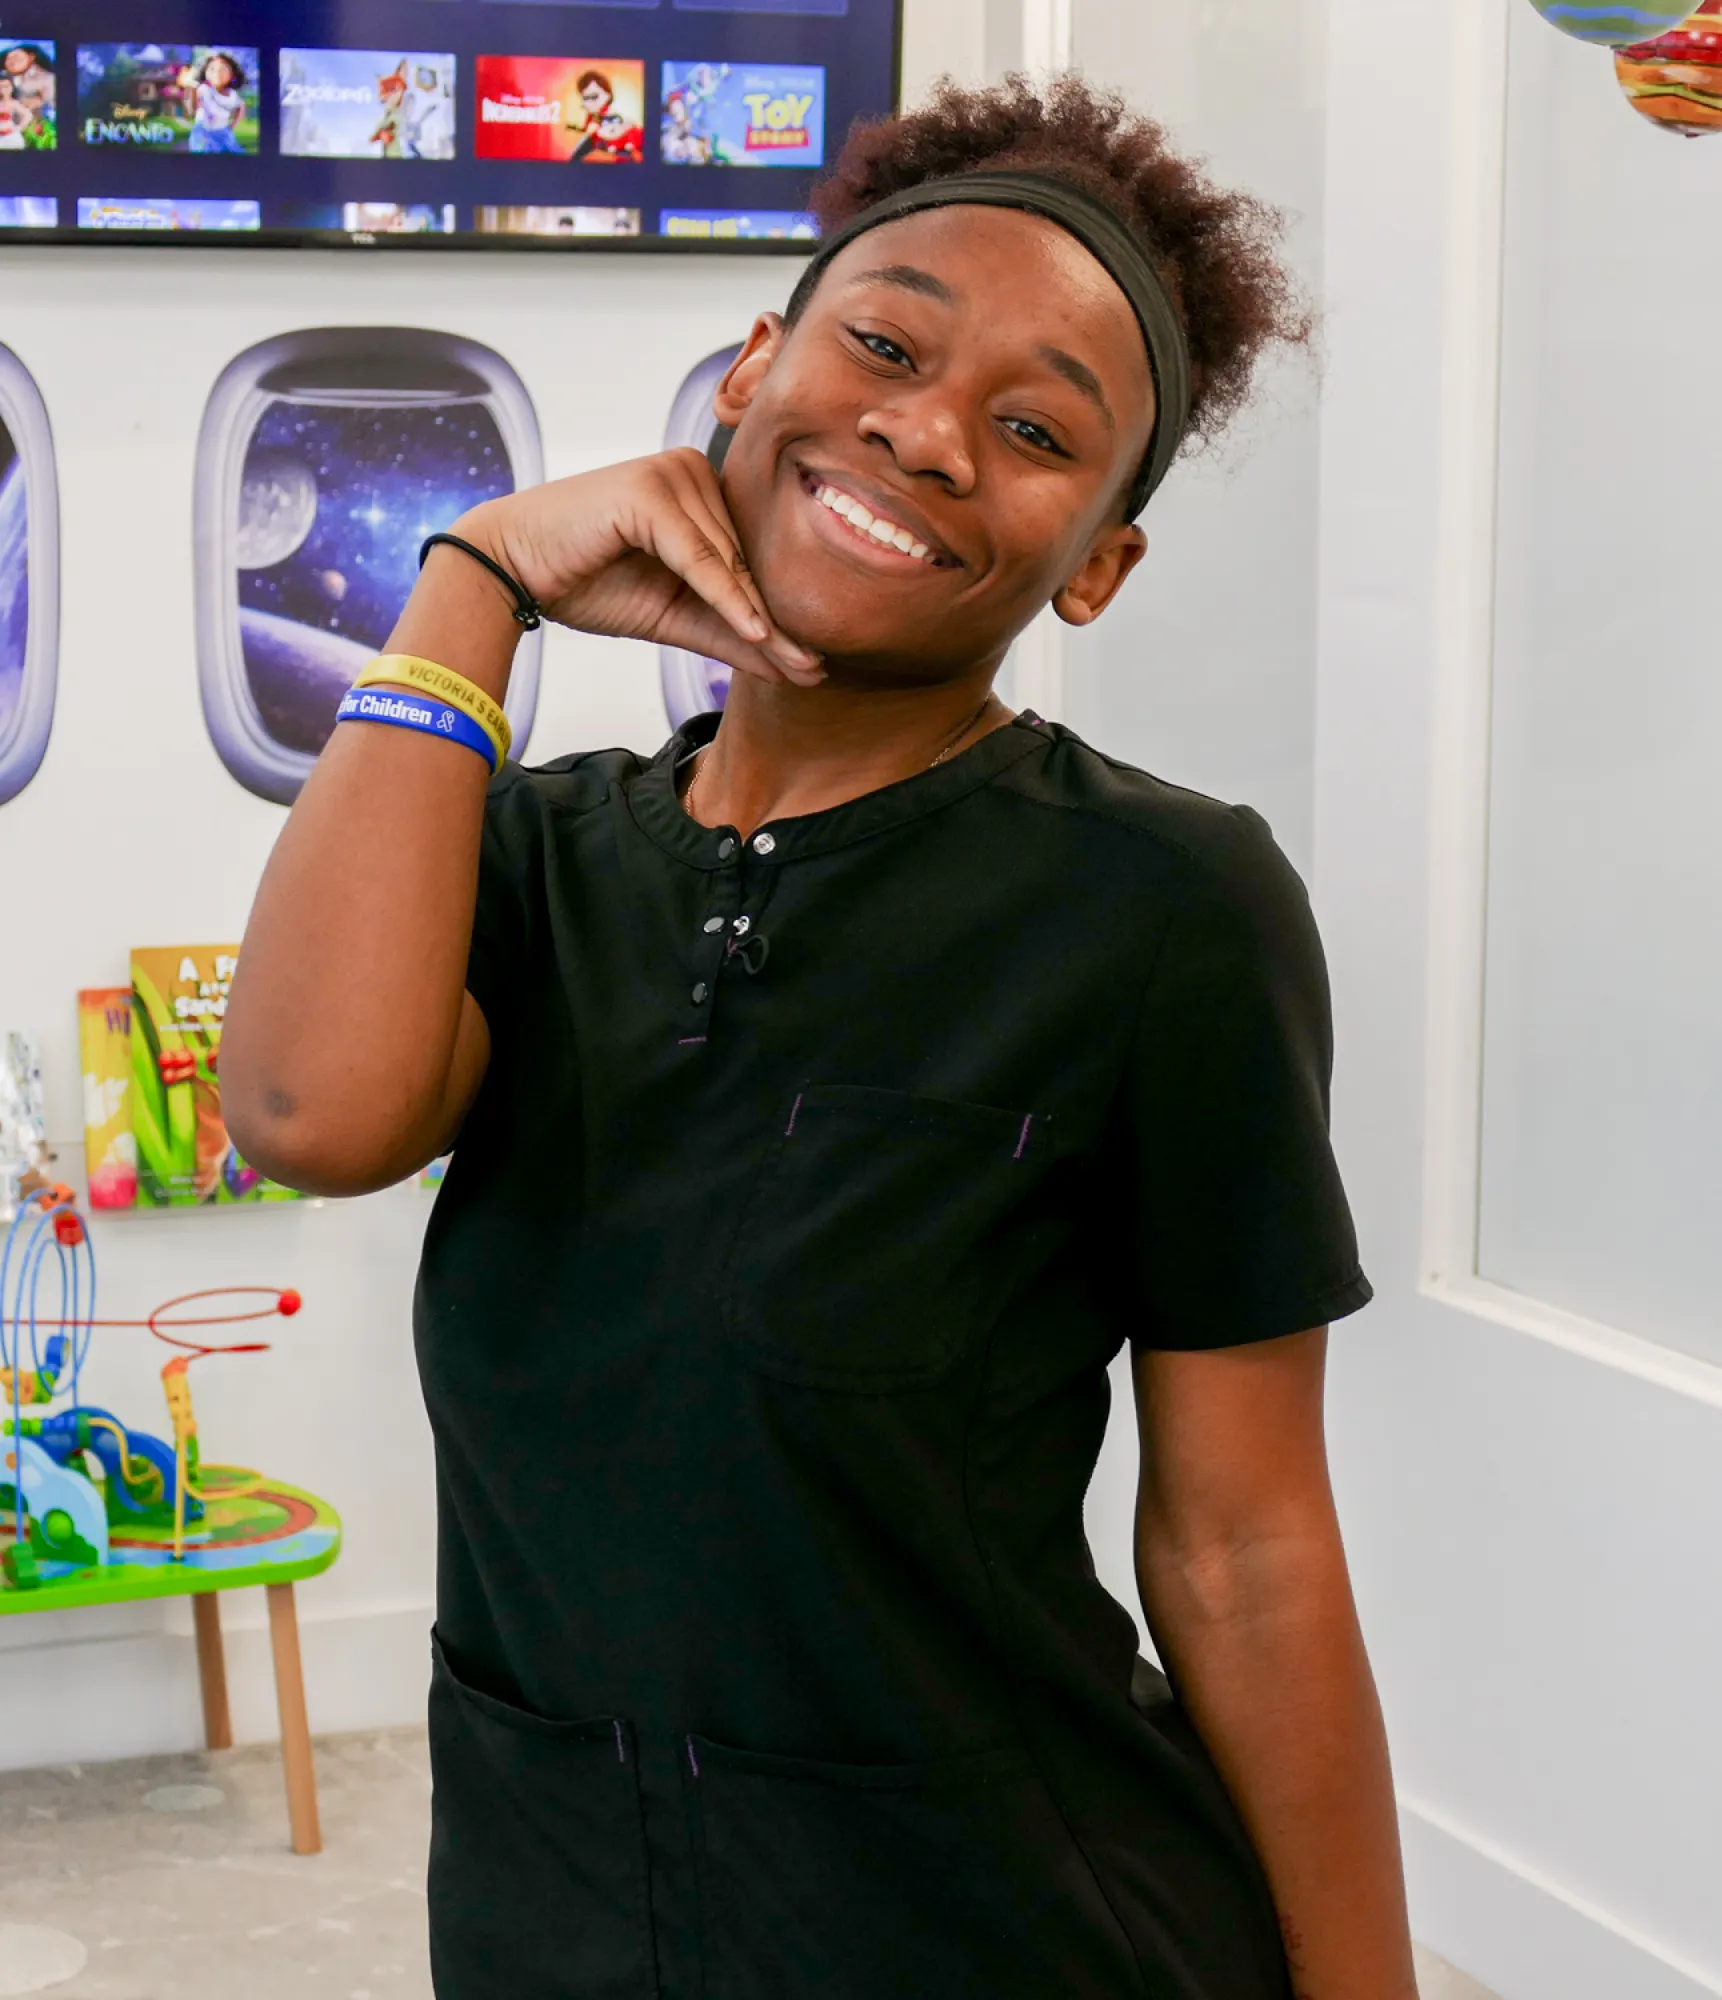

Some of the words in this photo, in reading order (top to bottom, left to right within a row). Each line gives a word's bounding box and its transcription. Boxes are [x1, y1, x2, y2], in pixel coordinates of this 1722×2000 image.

[743, 93, 814, 129] TOY
[85, 118, 174, 144] ENCANTO
[408, 663, 487, 715] VICTORIA'S
[360, 694, 433, 725] Children
[178, 956, 199, 983] A
